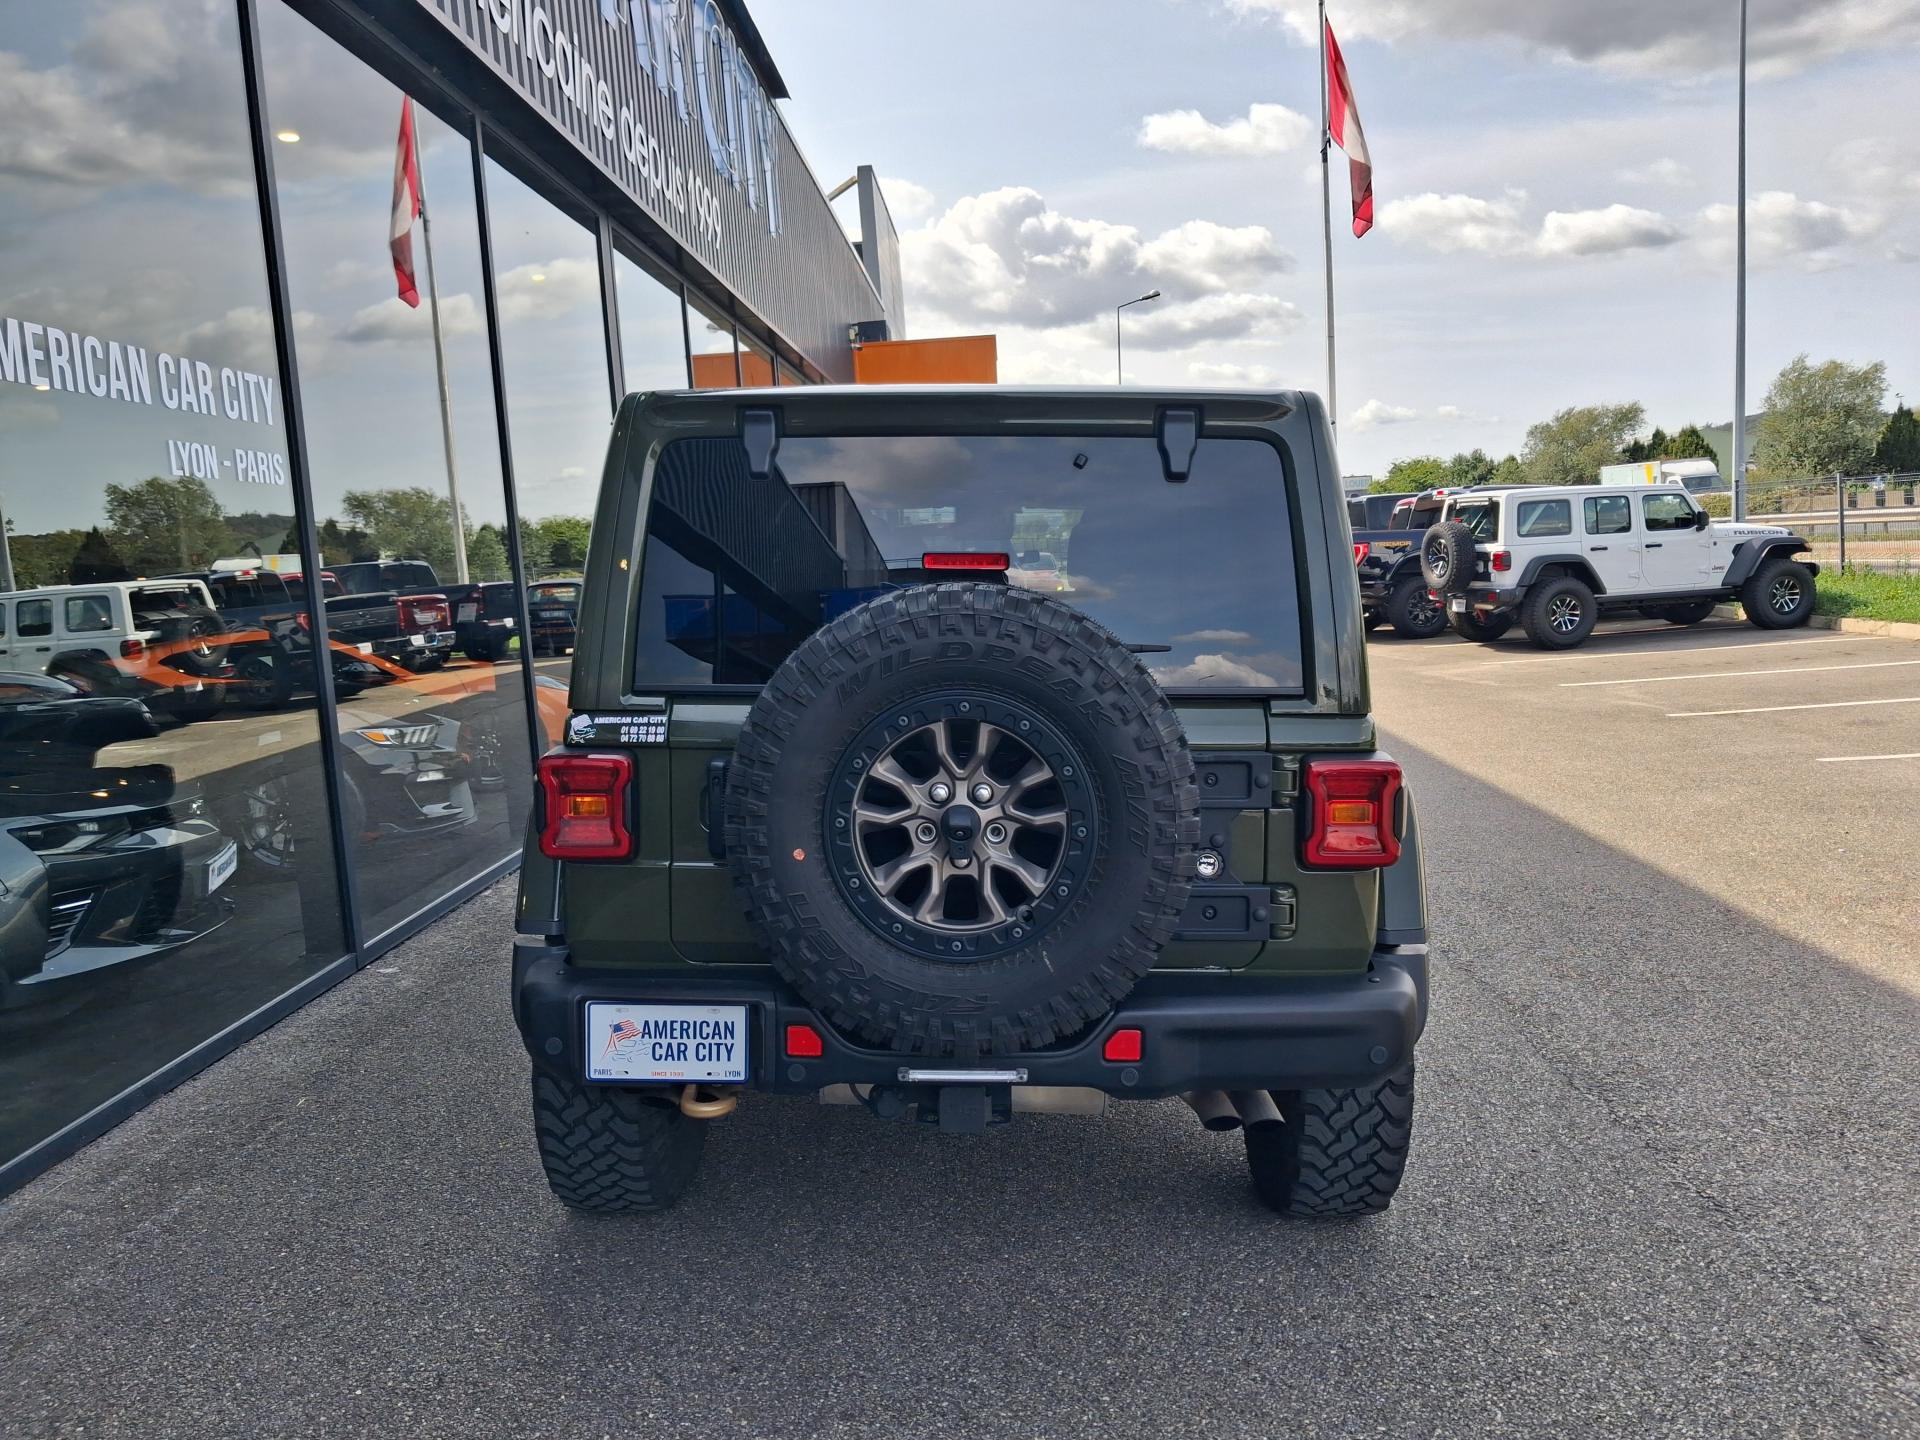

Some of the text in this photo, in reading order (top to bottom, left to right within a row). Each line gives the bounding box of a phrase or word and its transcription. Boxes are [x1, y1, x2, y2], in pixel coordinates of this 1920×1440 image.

[477, 0, 722, 249] ricaine depuis 1999
[158, 352, 217, 416] CAR
[221, 367, 274, 426] CITY
[168, 439, 219, 480] LYON
[235, 448, 285, 486] PARIS
[1733, 529, 1784, 537] RUBICON
[835, 640, 1121, 730] WILDPEAK
[593, 716, 667, 724] AMERICAN CAR CITY
[629, 734, 638, 743] 72
[1199, 856, 1215, 864] Jeep
[641, 1020, 735, 1040] AMERICAN
[651, 1041, 735, 1062] CAR CITY
[593, 1068, 613, 1077] PARIS
[724, 1068, 742, 1078] LYON
